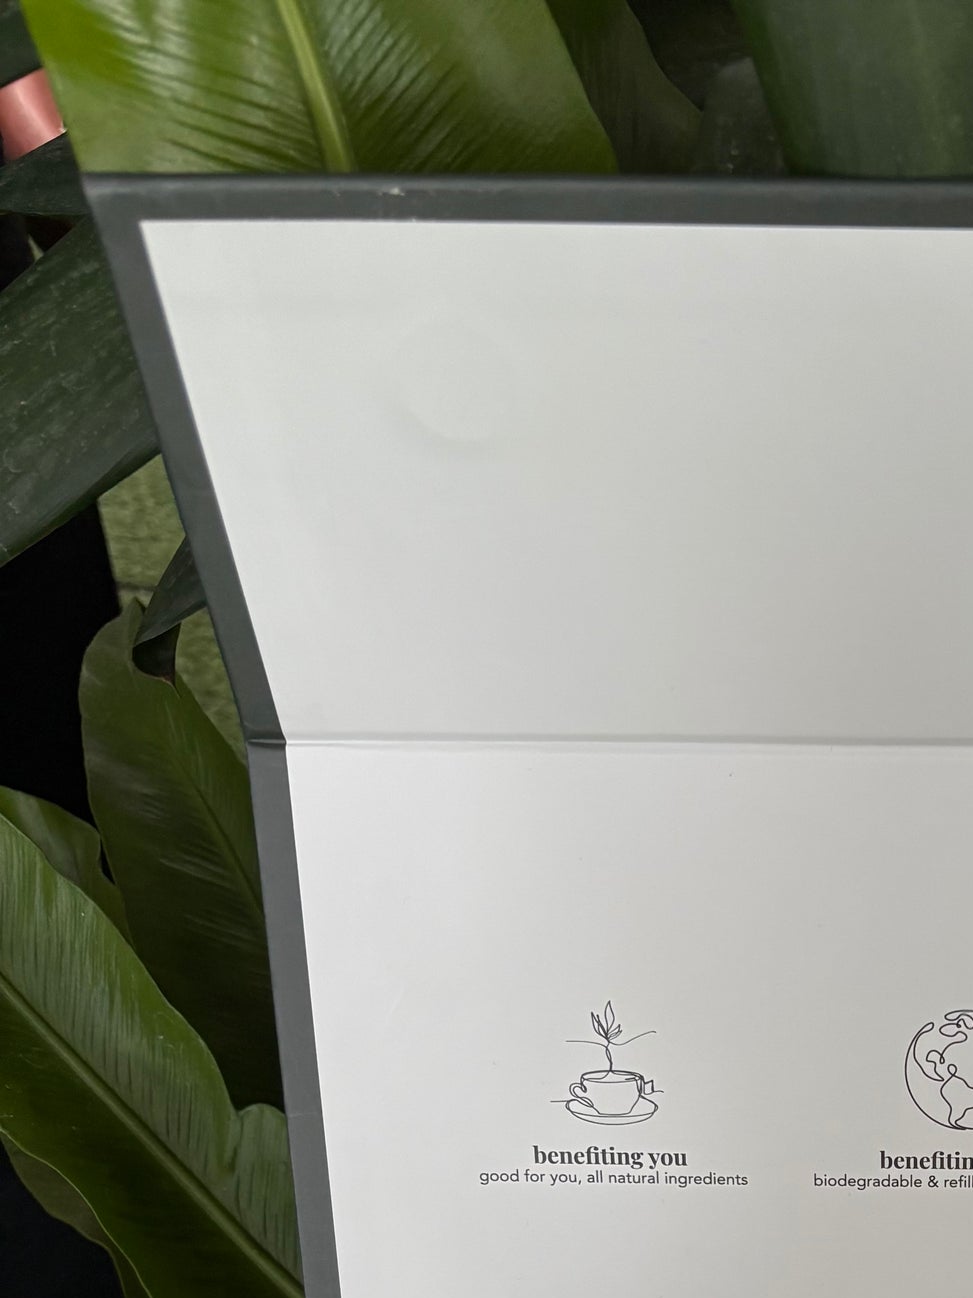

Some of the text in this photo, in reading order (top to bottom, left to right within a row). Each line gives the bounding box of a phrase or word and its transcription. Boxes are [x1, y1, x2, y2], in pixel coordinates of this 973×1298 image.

[532, 1145, 688, 1170] benefiting you
[479, 1169, 749, 1188] good for you, all natural ingredients
[813, 1173, 922, 1190] biodegradable
[927, 1175, 940, 1188] &
